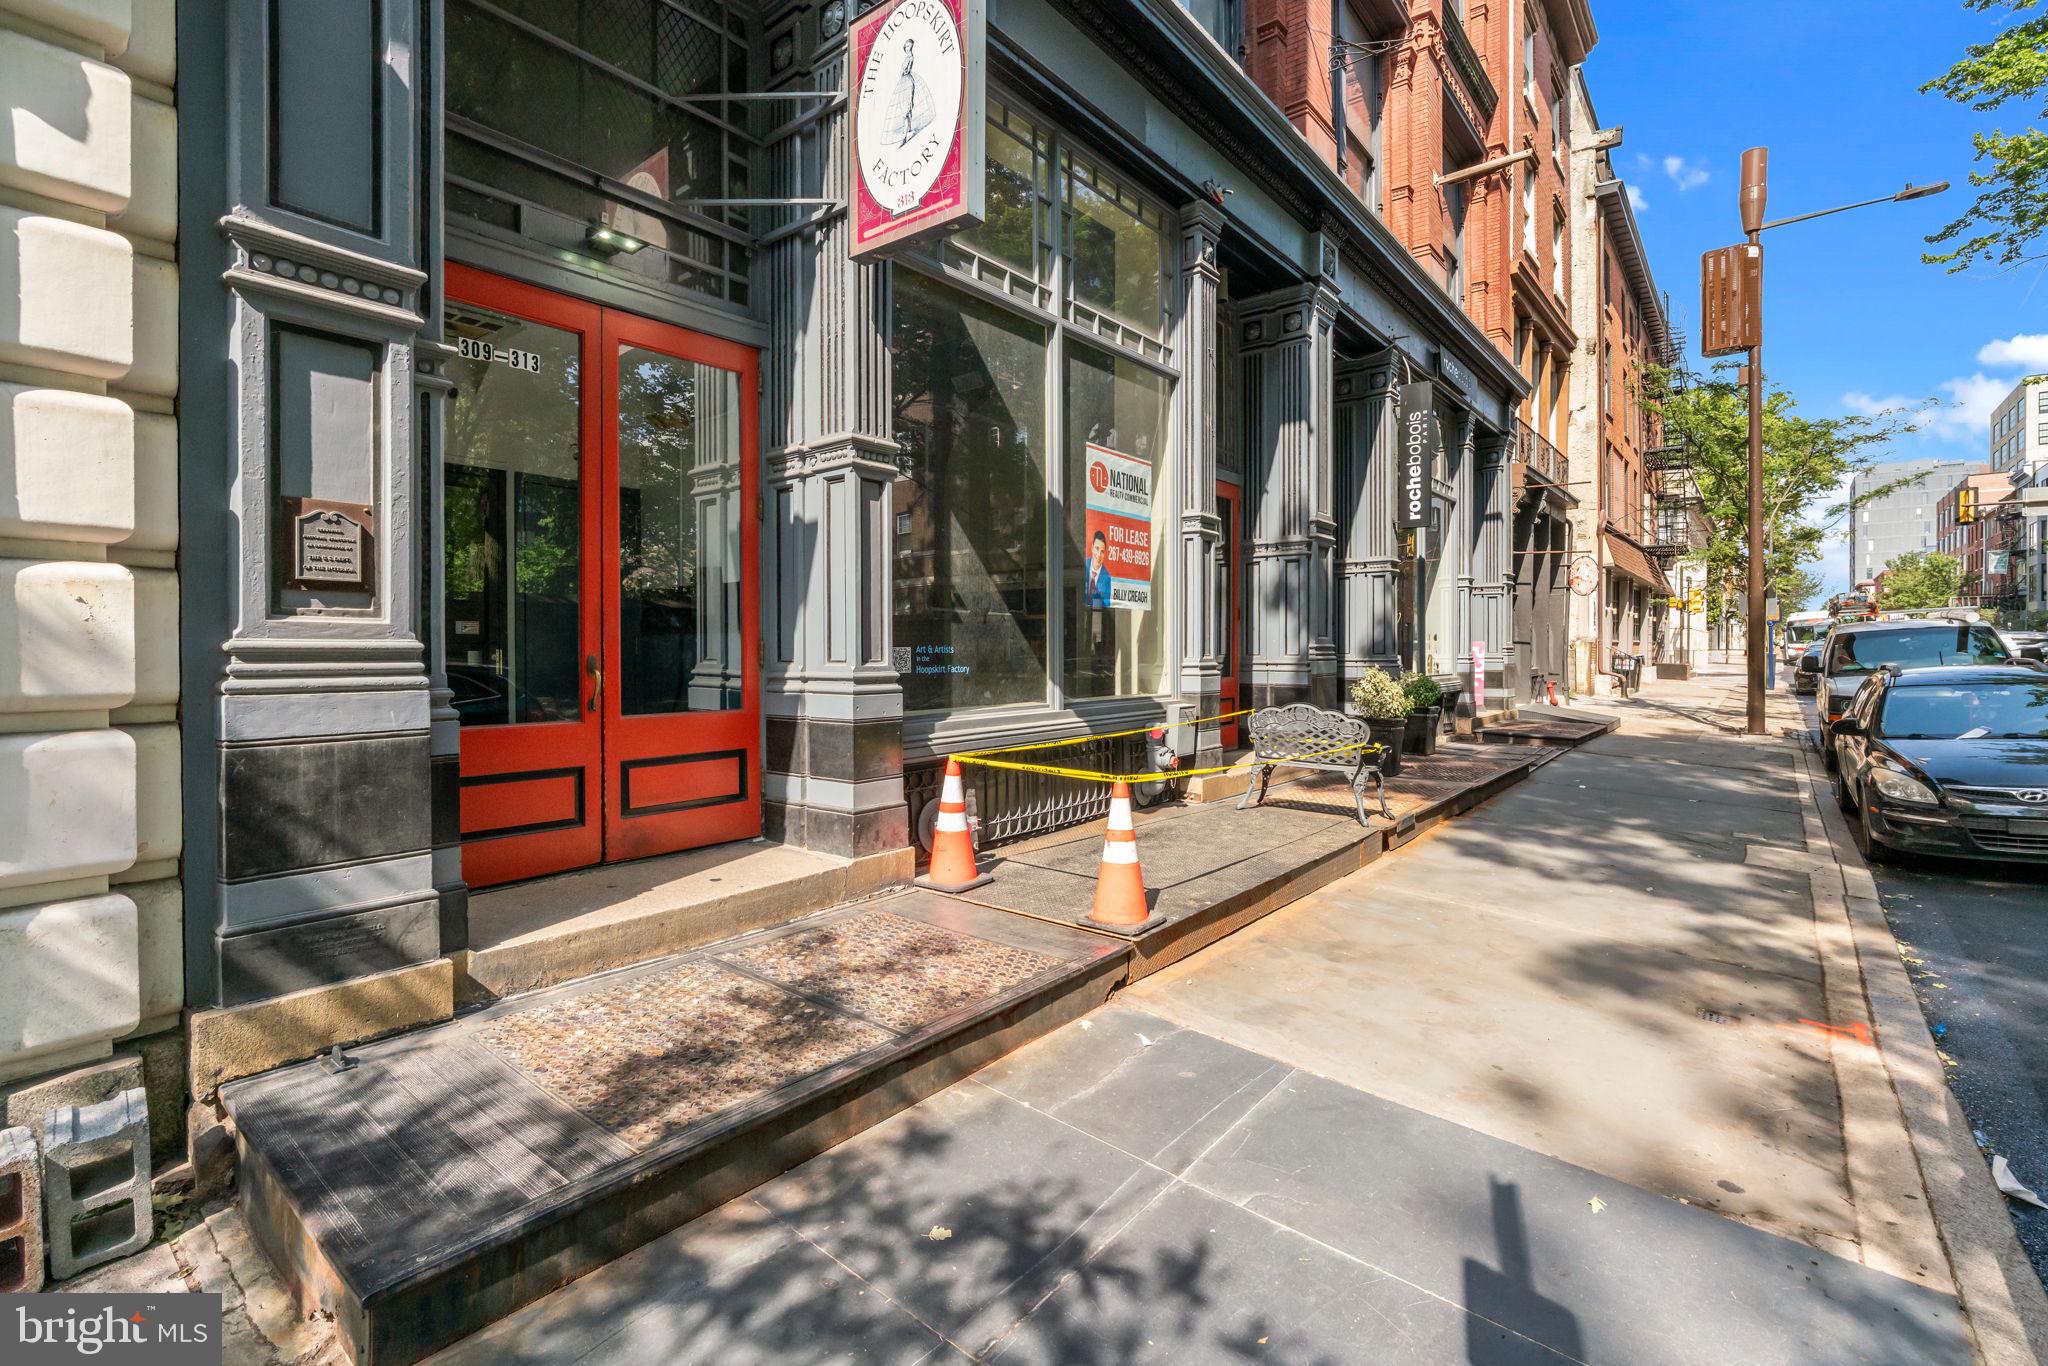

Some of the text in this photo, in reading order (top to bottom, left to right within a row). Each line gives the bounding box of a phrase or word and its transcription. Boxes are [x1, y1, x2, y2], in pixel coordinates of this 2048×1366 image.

[863, 1, 955, 99] THE HOOPSKIRT
[872, 133, 942, 188] FACTORY
[897, 191, 915, 208] 313
[1406, 411, 1421, 520] rochebobois
[1110, 469, 1148, 496] NATIONAL
[1110, 490, 1148, 506] REALTY COMMERCIAL
[1109, 526, 1148, 547] FOR LEASE
[1113, 588, 1148, 603] BILLY CREAGH
[916, 645, 955, 653] Art & Artists
[916, 665, 970, 674] Hoopskirt Factory
